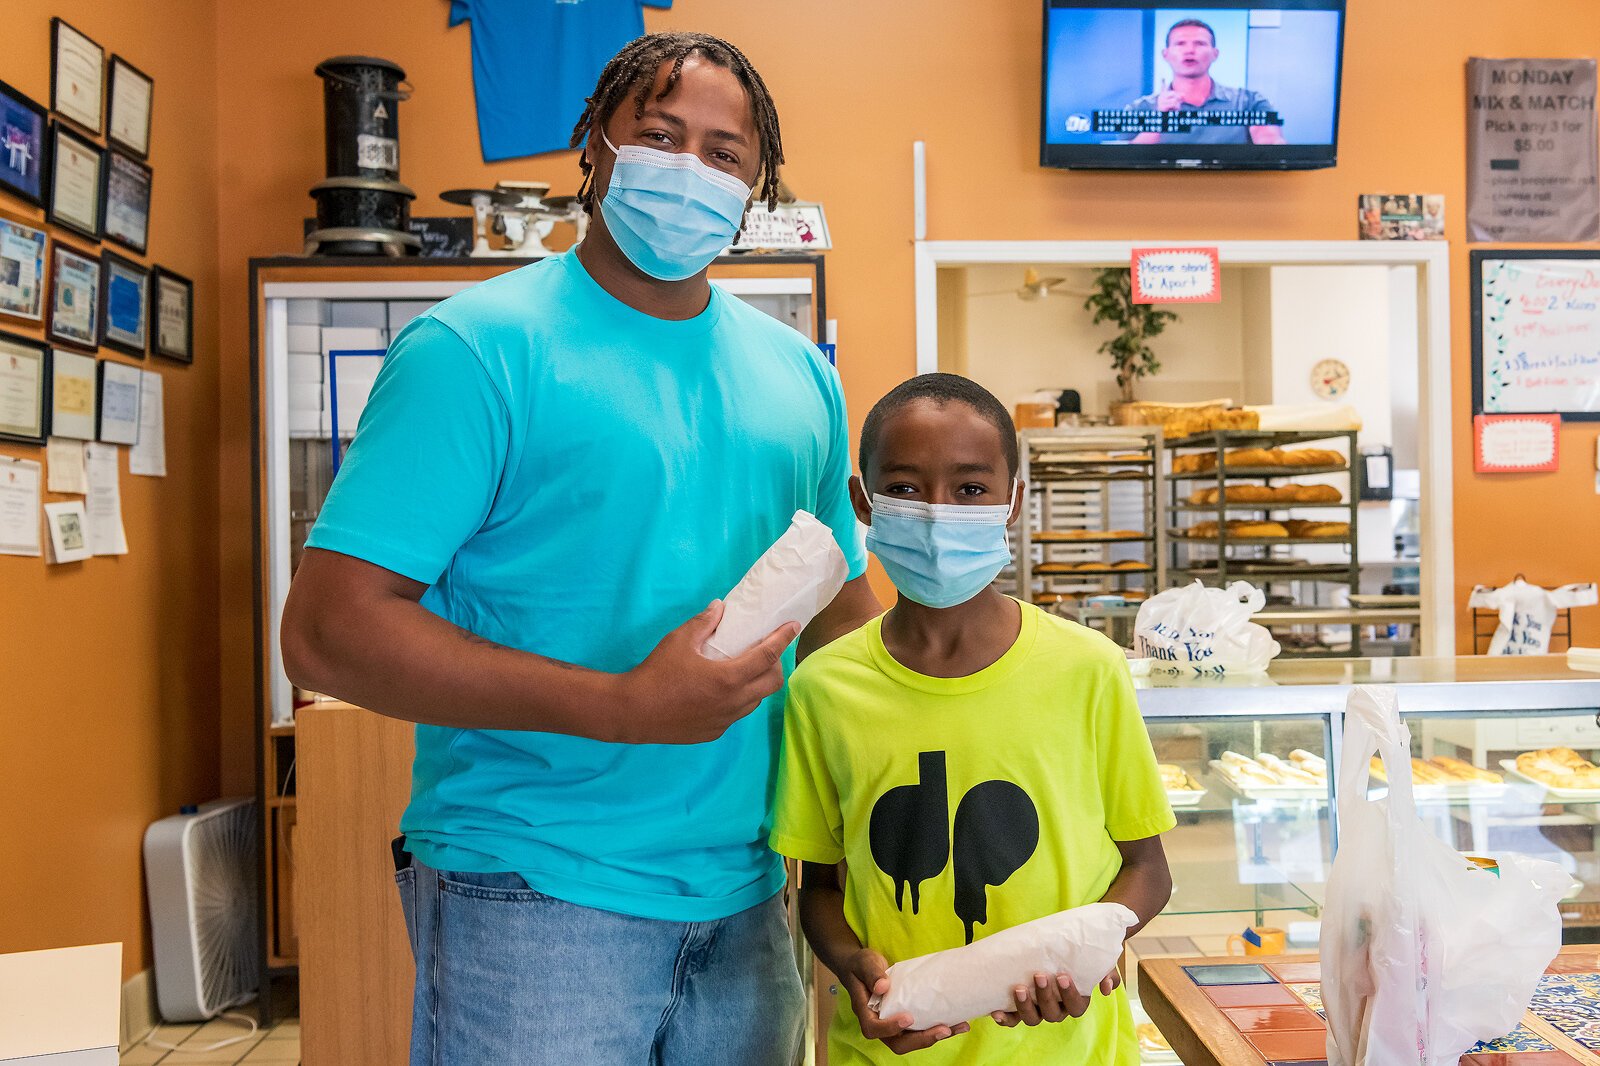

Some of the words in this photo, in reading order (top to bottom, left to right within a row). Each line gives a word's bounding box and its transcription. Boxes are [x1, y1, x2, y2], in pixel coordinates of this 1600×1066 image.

[1492, 70, 1574, 84] MONDAY
[1473, 95, 1504, 109] MIX
[1510, 95, 1523, 109] &
[1528, 96, 1594, 110] MATCH
[1485, 121, 1515, 132] Pick
[1521, 122, 1547, 135] any
[1551, 121, 1559, 132] 3
[1563, 121, 1582, 132] for
[1514, 139, 1554, 152] $5.00
[1139, 259, 1174, 273] Please
[1181, 262, 1208, 272] stand
[1161, 276, 1197, 291] Apart
[1139, 635, 1178, 661] Thank
[1184, 642, 1213, 661] You
